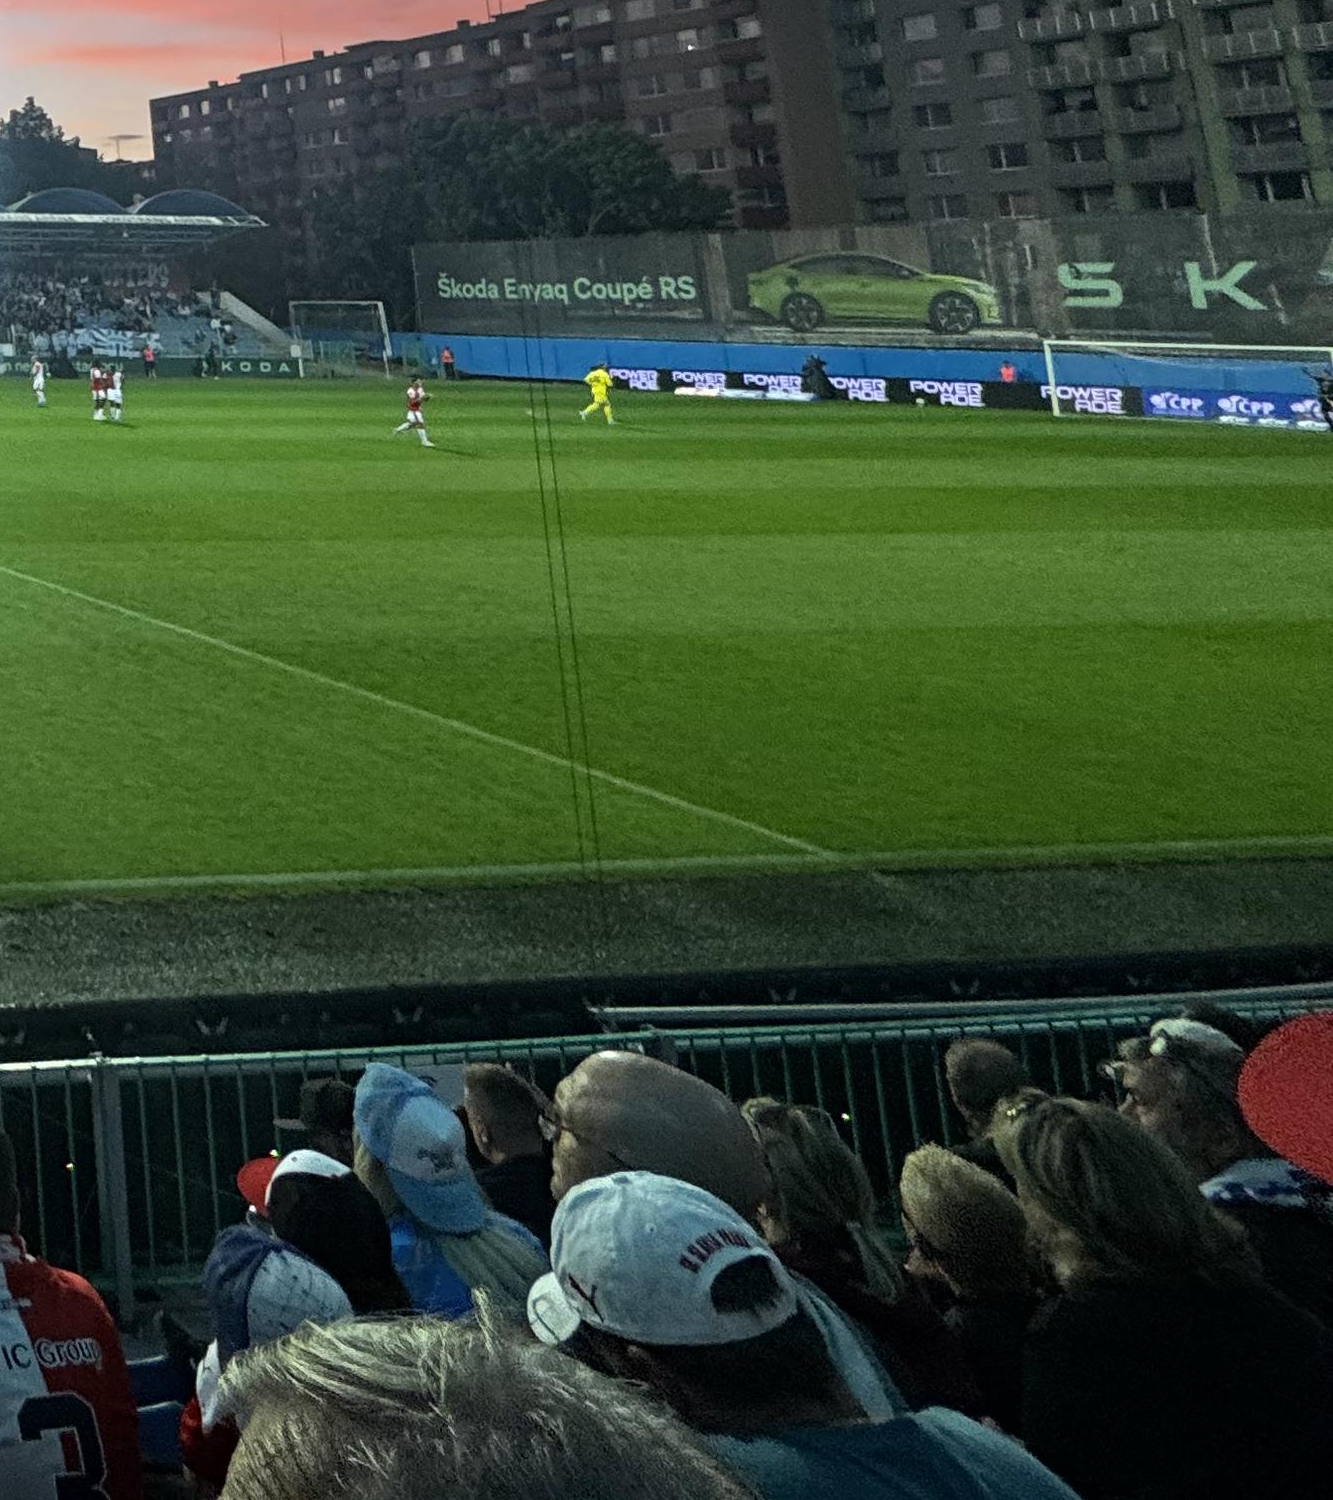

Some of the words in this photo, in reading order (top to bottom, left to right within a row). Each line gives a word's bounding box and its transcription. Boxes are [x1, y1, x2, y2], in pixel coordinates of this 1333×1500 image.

[437, 272, 499, 299] Škoda
[503, 277, 569, 305] Enyaq
[573, 275, 654, 305] Coupé
[658, 275, 696, 300] RS
[221, 361, 291, 372] KODA
[672, 371, 726, 385] POWER
[743, 373, 802, 389] POWER
[828, 377, 886, 391] OWER
[910, 380, 983, 396] POWER
[1040, 385, 1123, 401] POWER
